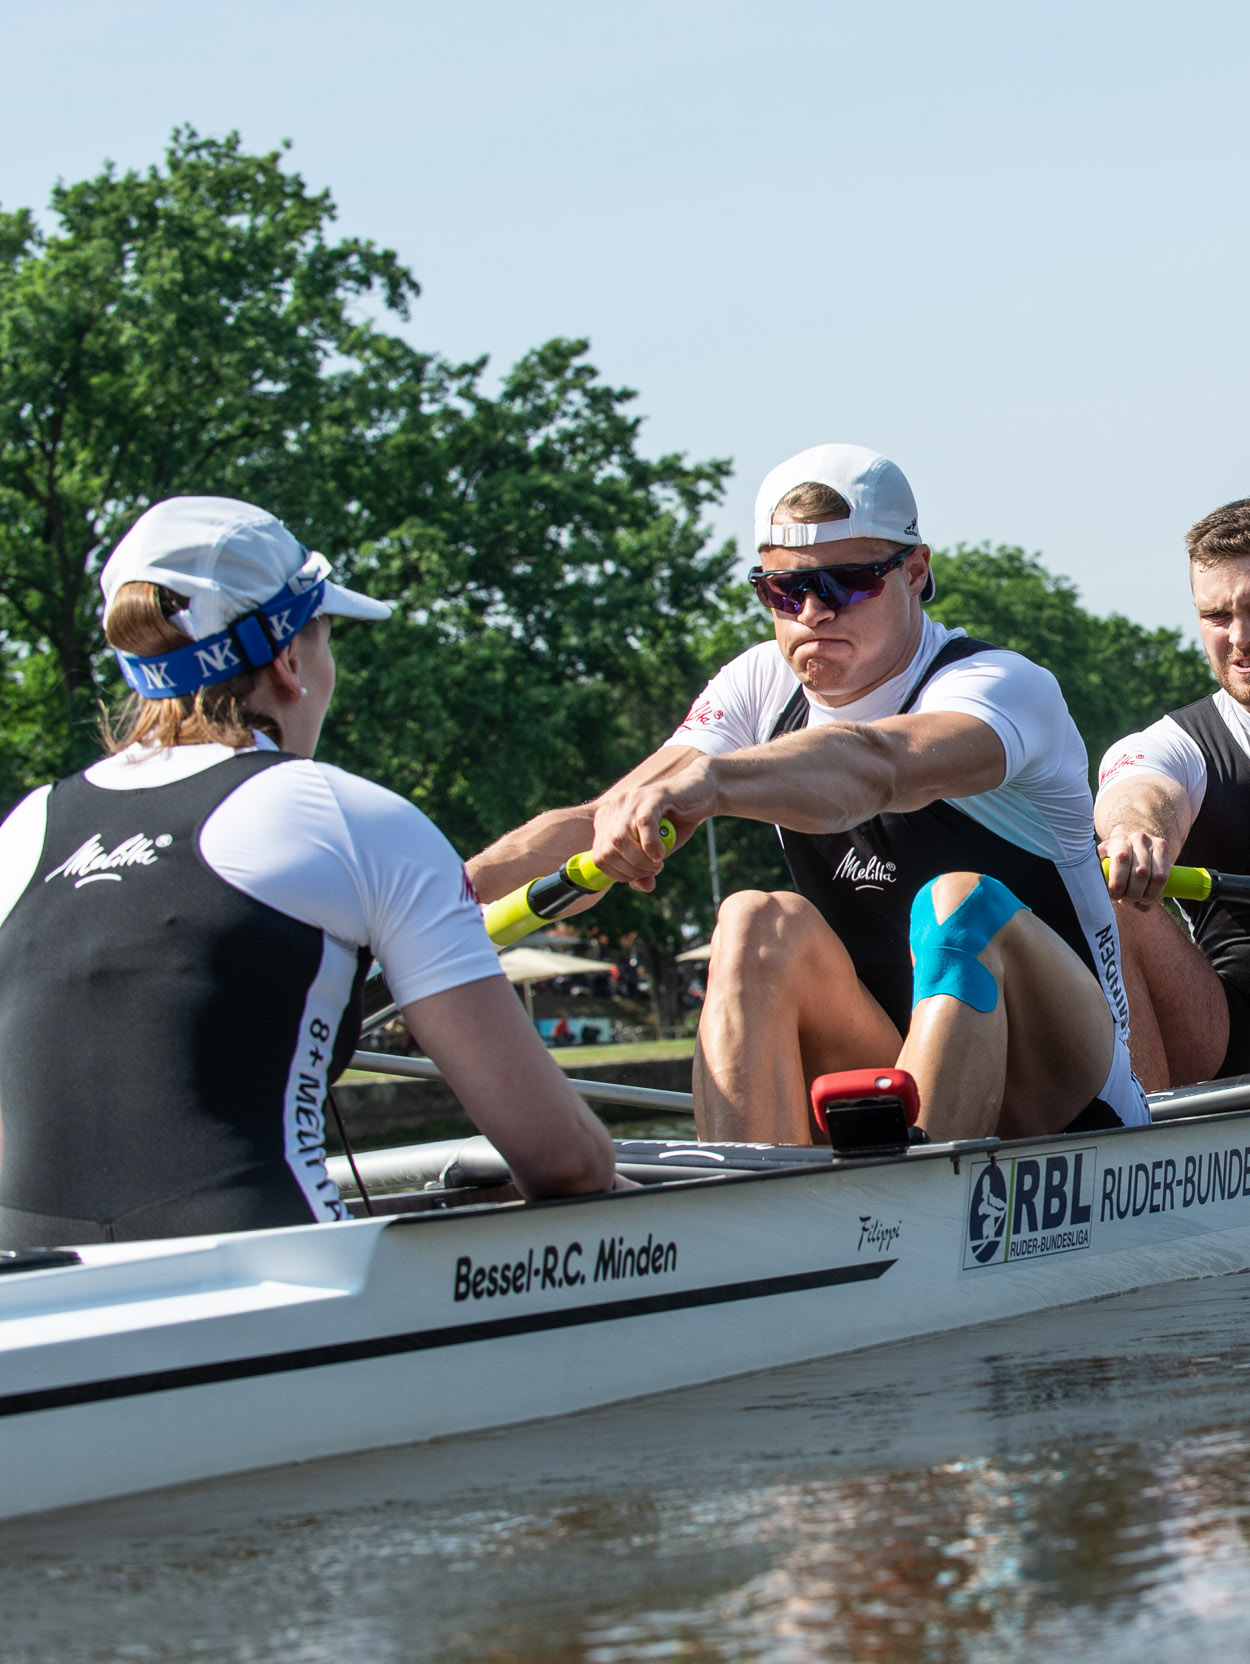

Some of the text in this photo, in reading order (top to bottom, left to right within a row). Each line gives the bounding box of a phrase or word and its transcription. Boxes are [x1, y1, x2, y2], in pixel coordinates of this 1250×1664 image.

[139, 661, 177, 690] NK
[194, 638, 240, 679] NK
[1012, 1153, 1092, 1235] RBL
[857, 1215, 902, 1251] Filippi
[1010, 1228, 1089, 1258] RUDER-BUNDESLIGA
[453, 1232, 677, 1302] Bessel-R.C. Minden
